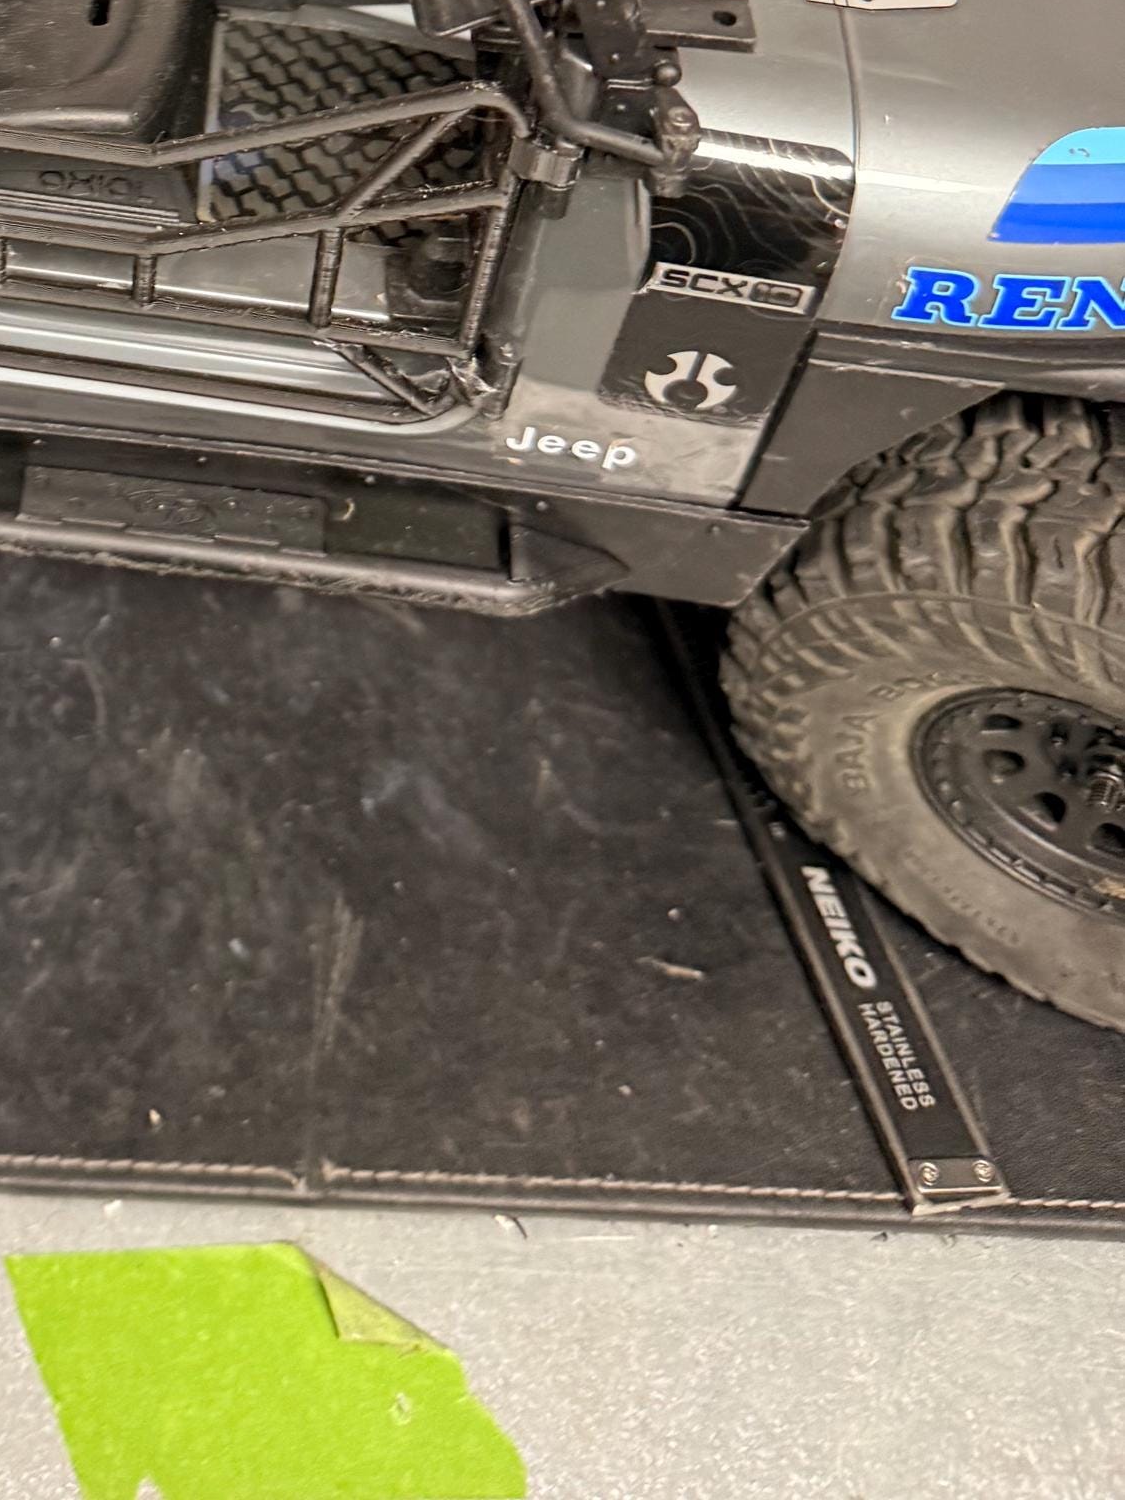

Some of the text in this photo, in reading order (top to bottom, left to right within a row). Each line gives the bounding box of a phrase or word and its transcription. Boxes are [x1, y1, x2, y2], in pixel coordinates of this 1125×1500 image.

[891, 265, 1125, 331] REN
[505, 426, 637, 470] Jeep
[801, 866, 878, 990] NEIKO
[857, 1002, 919, 1112] HARDENED
[875, 1000, 937, 1109] STAINLESS
